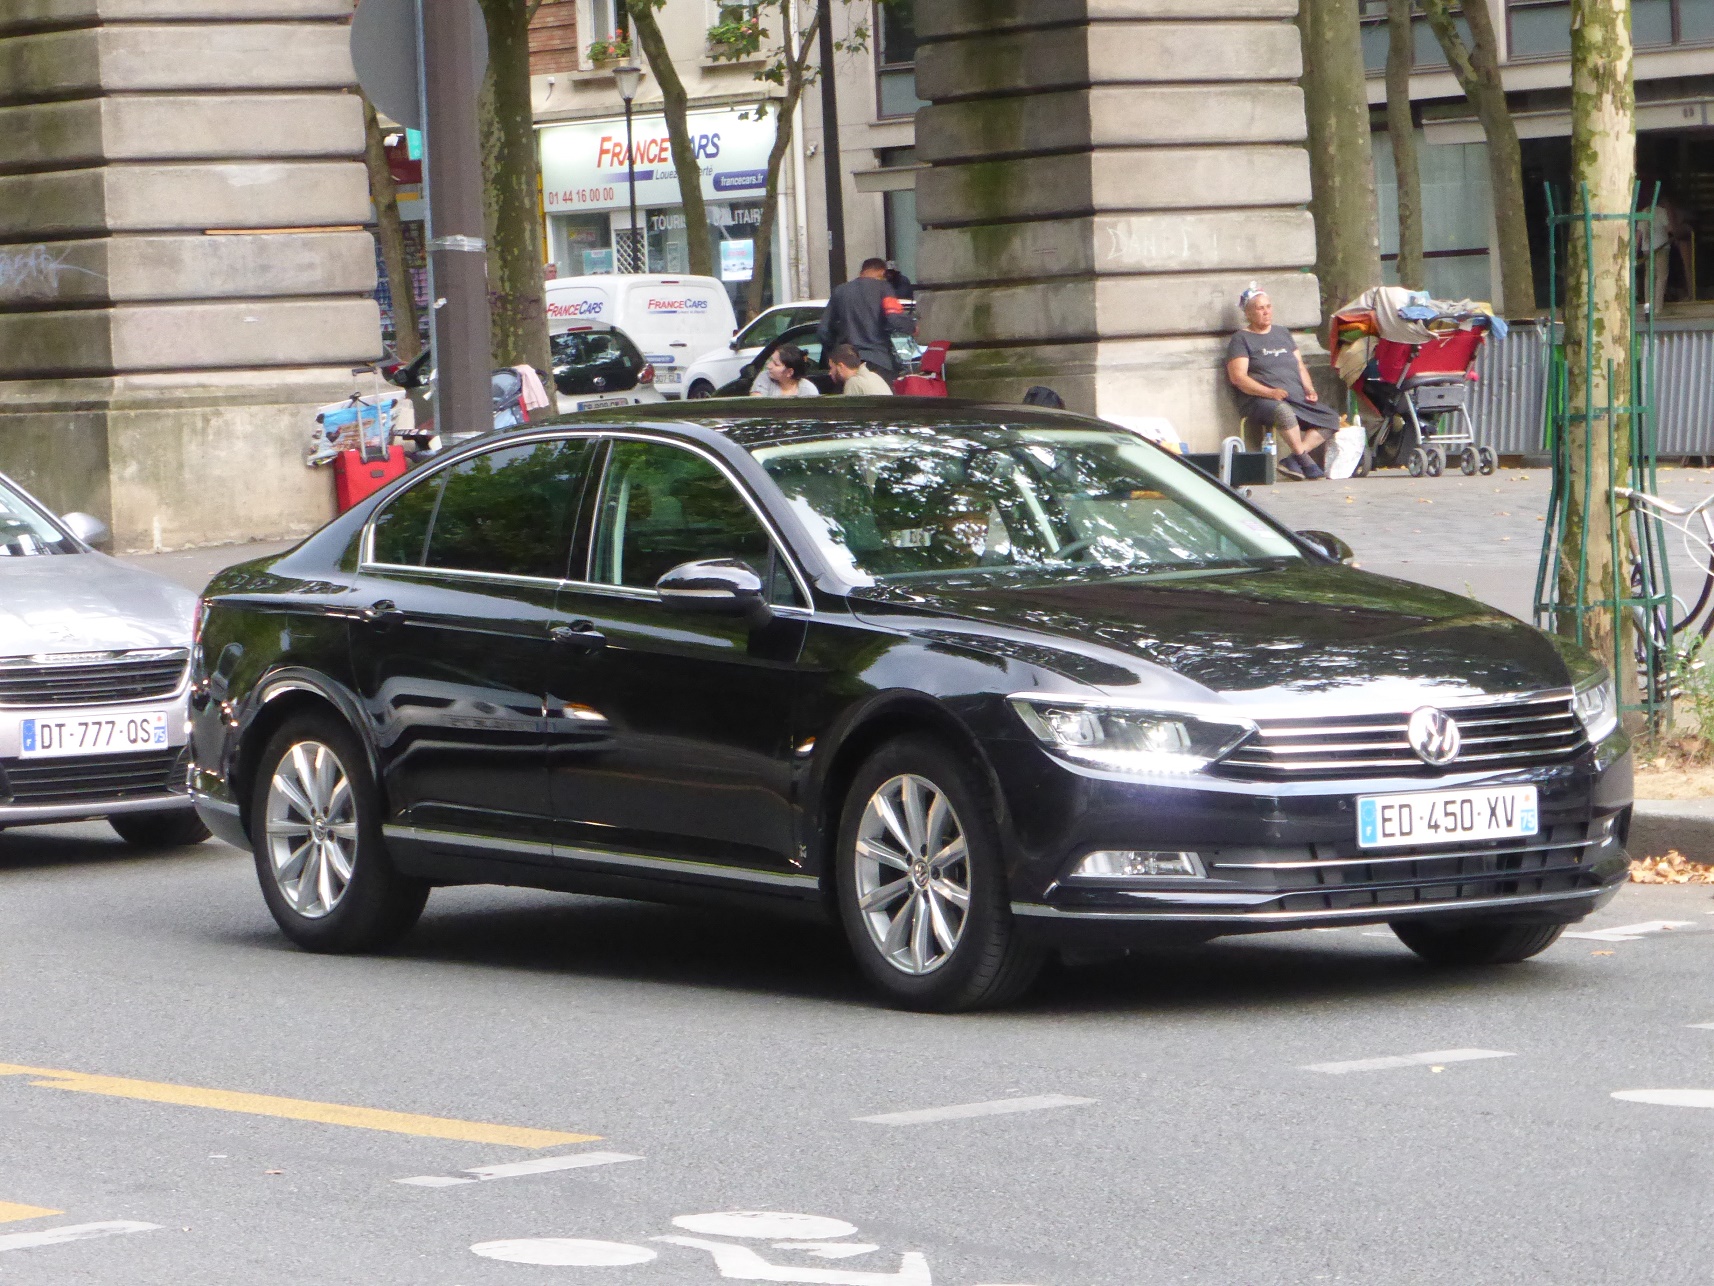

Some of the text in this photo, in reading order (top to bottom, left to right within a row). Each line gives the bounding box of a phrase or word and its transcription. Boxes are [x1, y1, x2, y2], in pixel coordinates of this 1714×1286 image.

[721, 174, 764, 187] francecars.fr
[549, 187, 613, 204] 01 44 16 00 00
[154, 728, 166, 742] 75
[1521, 812, 1535, 829] 75
